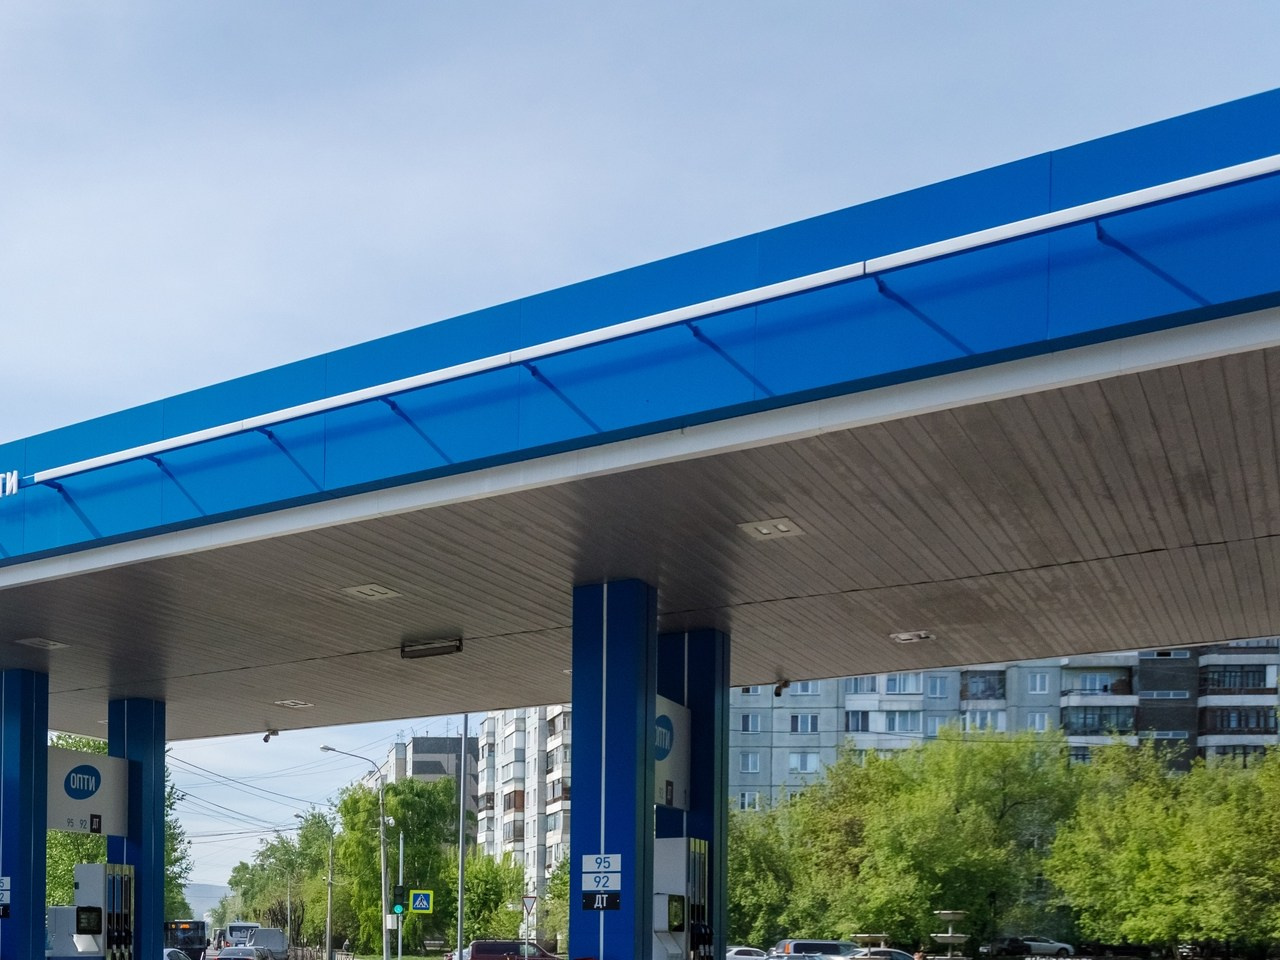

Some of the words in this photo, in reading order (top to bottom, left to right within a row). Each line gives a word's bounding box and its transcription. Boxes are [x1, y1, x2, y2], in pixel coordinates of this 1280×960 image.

[70, 773, 96, 792] ОПТИ
[66, 817, 74, 828] 95
[79, 819, 88, 829] 92
[92, 818, 100, 830] ДТ
[595, 857, 611, 869] 95
[594, 875, 610, 888] 92
[594, 894, 609, 909] ДТ
